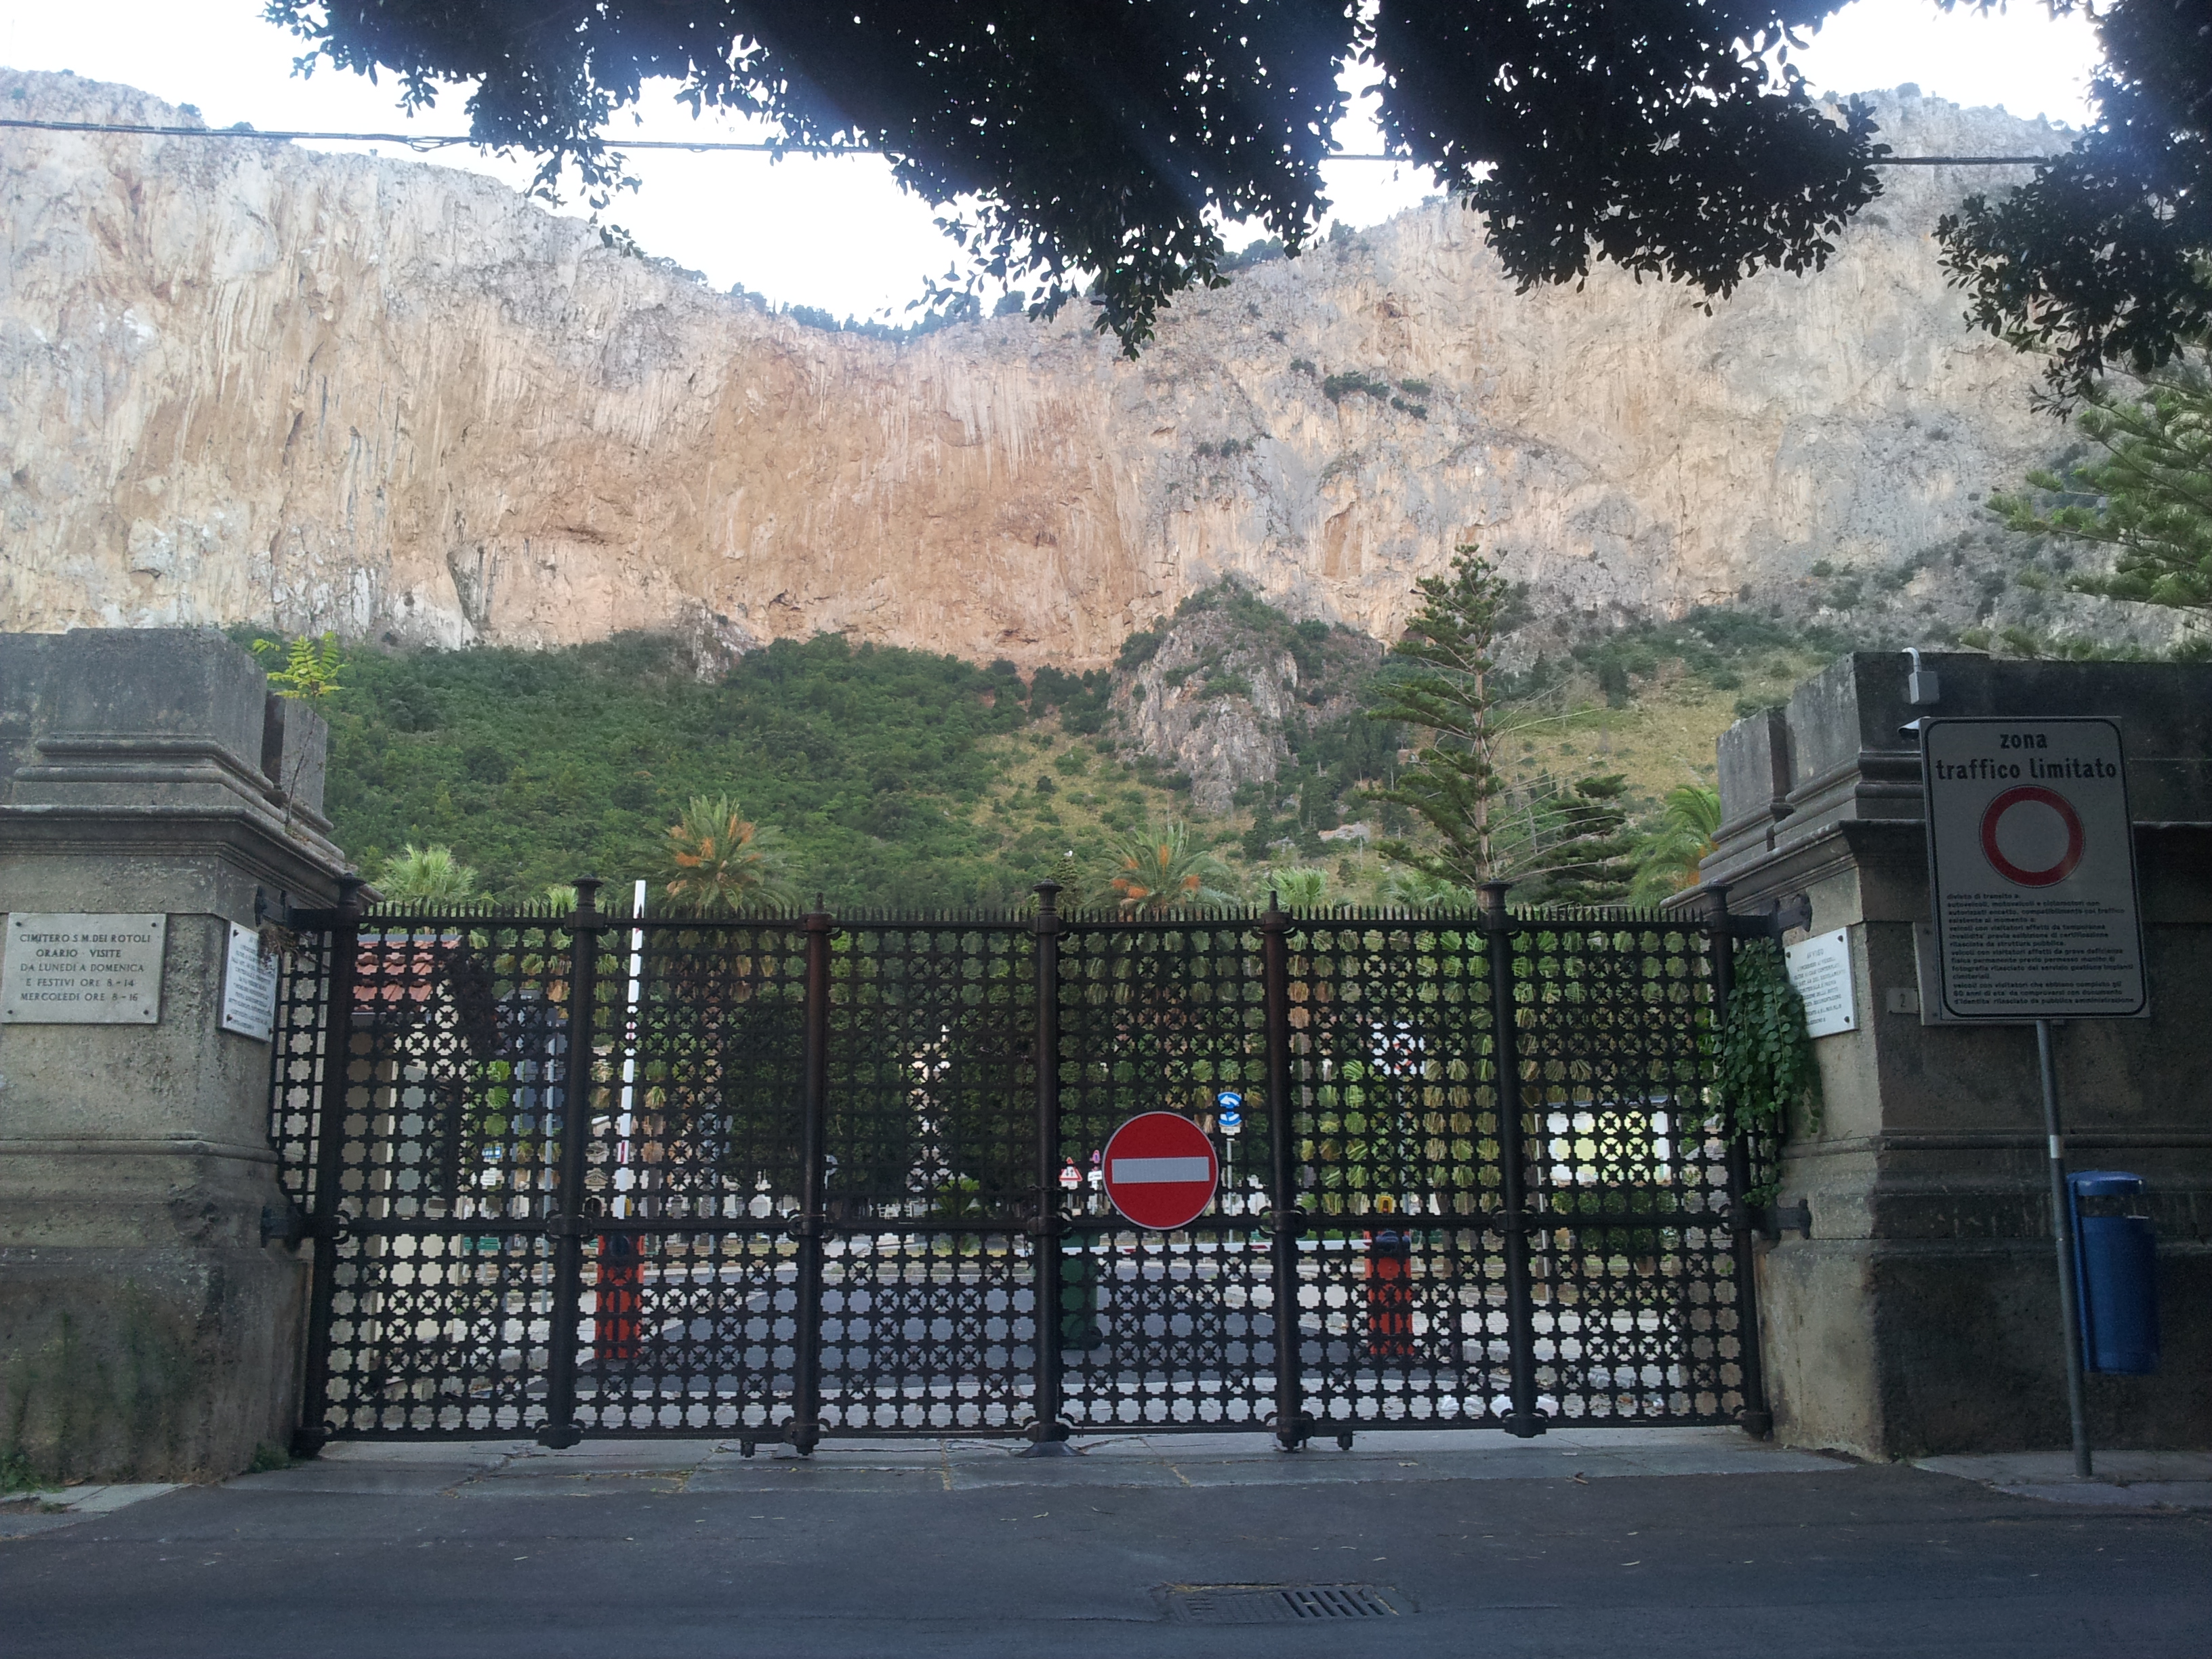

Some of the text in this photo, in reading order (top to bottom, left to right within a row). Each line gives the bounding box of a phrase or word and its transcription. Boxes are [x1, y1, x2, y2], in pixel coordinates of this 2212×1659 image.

[2000, 733, 2047, 749] zona
[1936, 758, 2116, 779] traffico limitato
[20, 935, 69, 943] CIMITERO
[111, 935, 150, 943] ROTOLI
[36, 949, 121, 958] ORARIO VISITE
[39, 964, 76, 972] LUNEDI
[91, 964, 144, 972] DOMENICA
[80, 979, 100, 987] ORE
[124, 979, 134, 987] 14
[20, 993, 79, 1001] MERCOLEDI
[85, 993, 105, 1001] ORE
